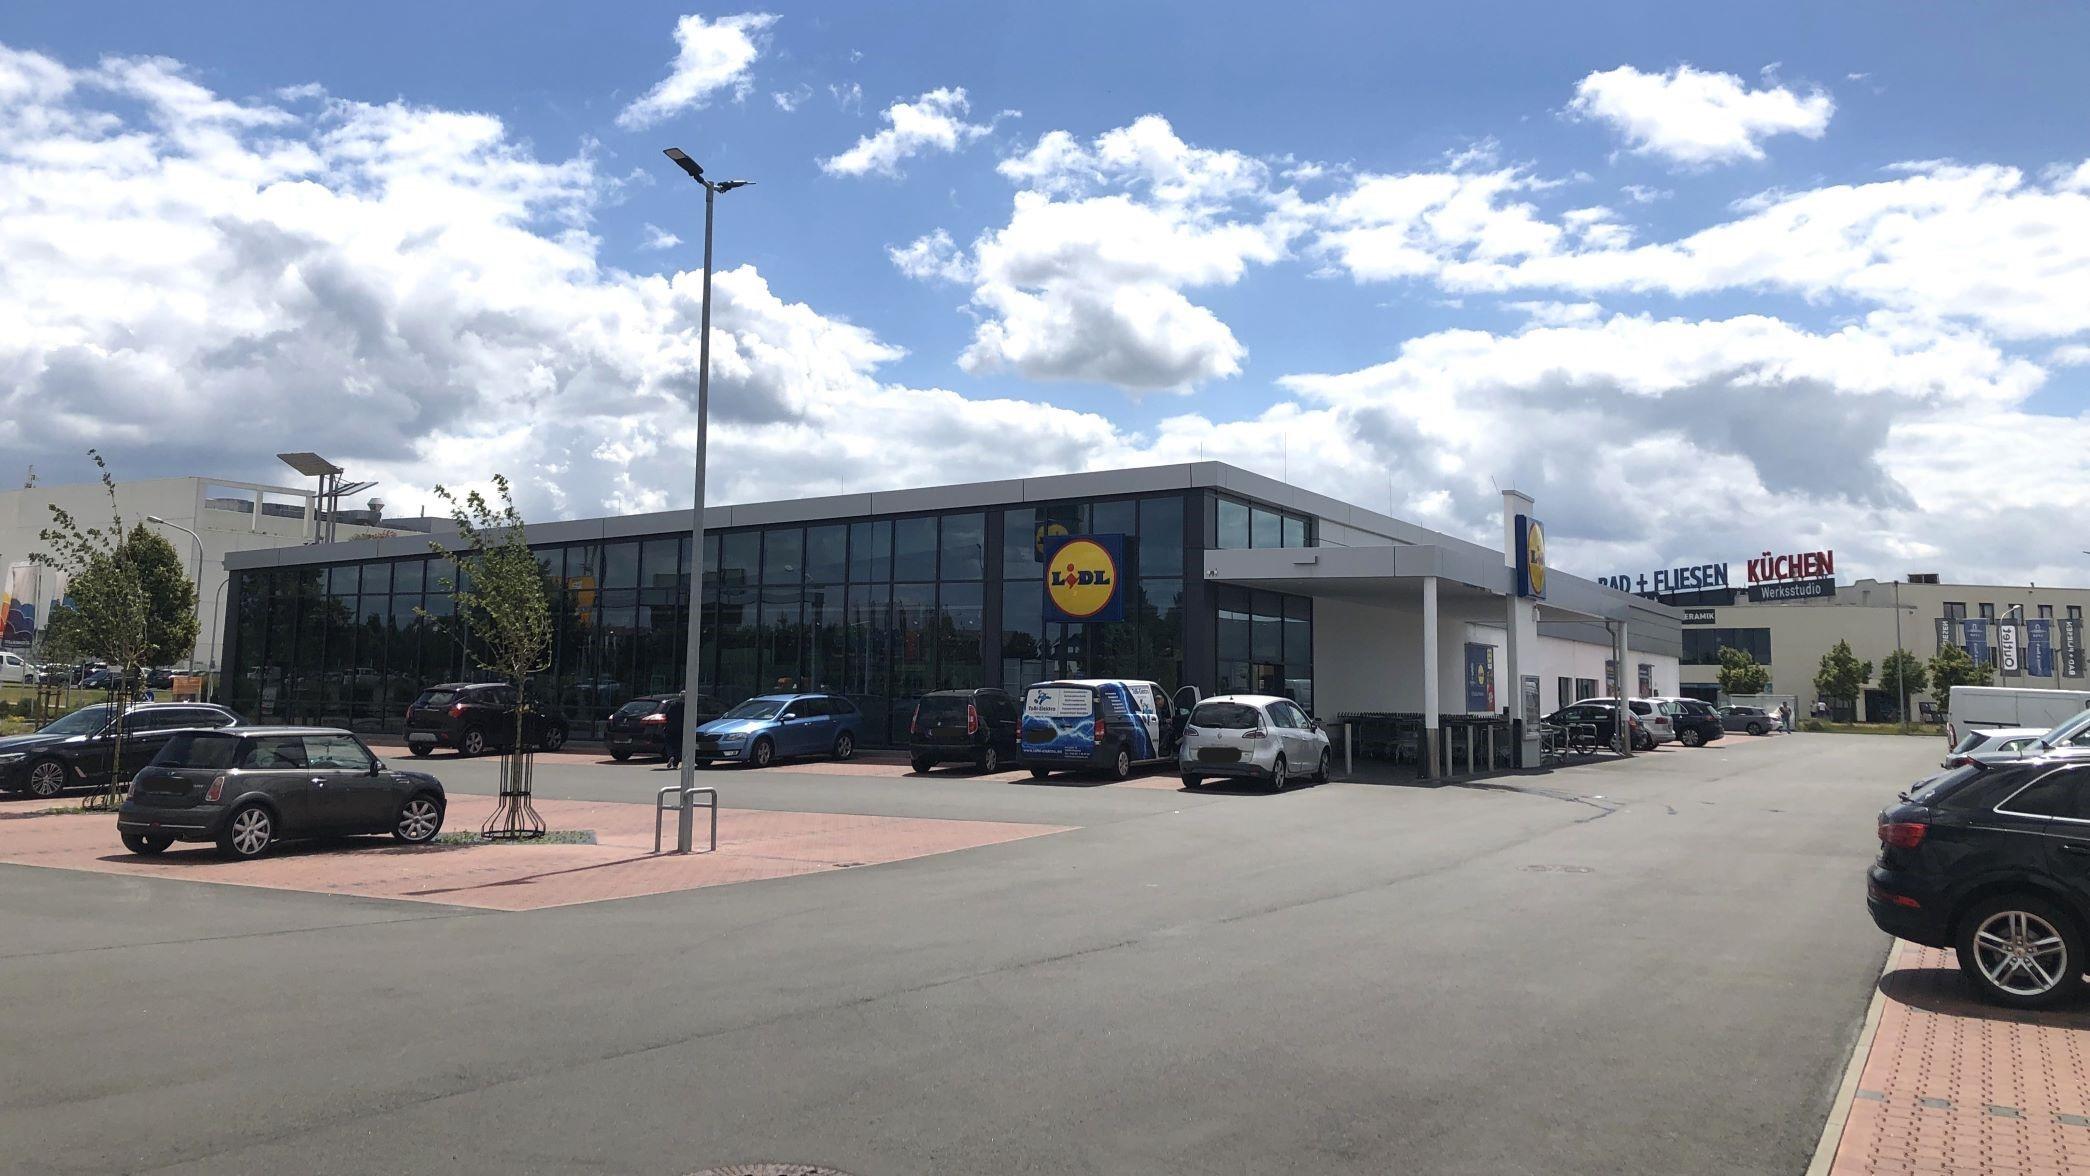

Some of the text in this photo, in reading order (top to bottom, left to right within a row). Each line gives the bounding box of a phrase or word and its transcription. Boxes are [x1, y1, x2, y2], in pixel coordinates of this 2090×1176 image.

[1653, 562, 1728, 591] FLIESEN
[1747, 549, 1834, 582] KÜCHEN
[1761, 583, 1822, 599] Werksstudio
[1684, 612, 1715, 621] ERAMIK
